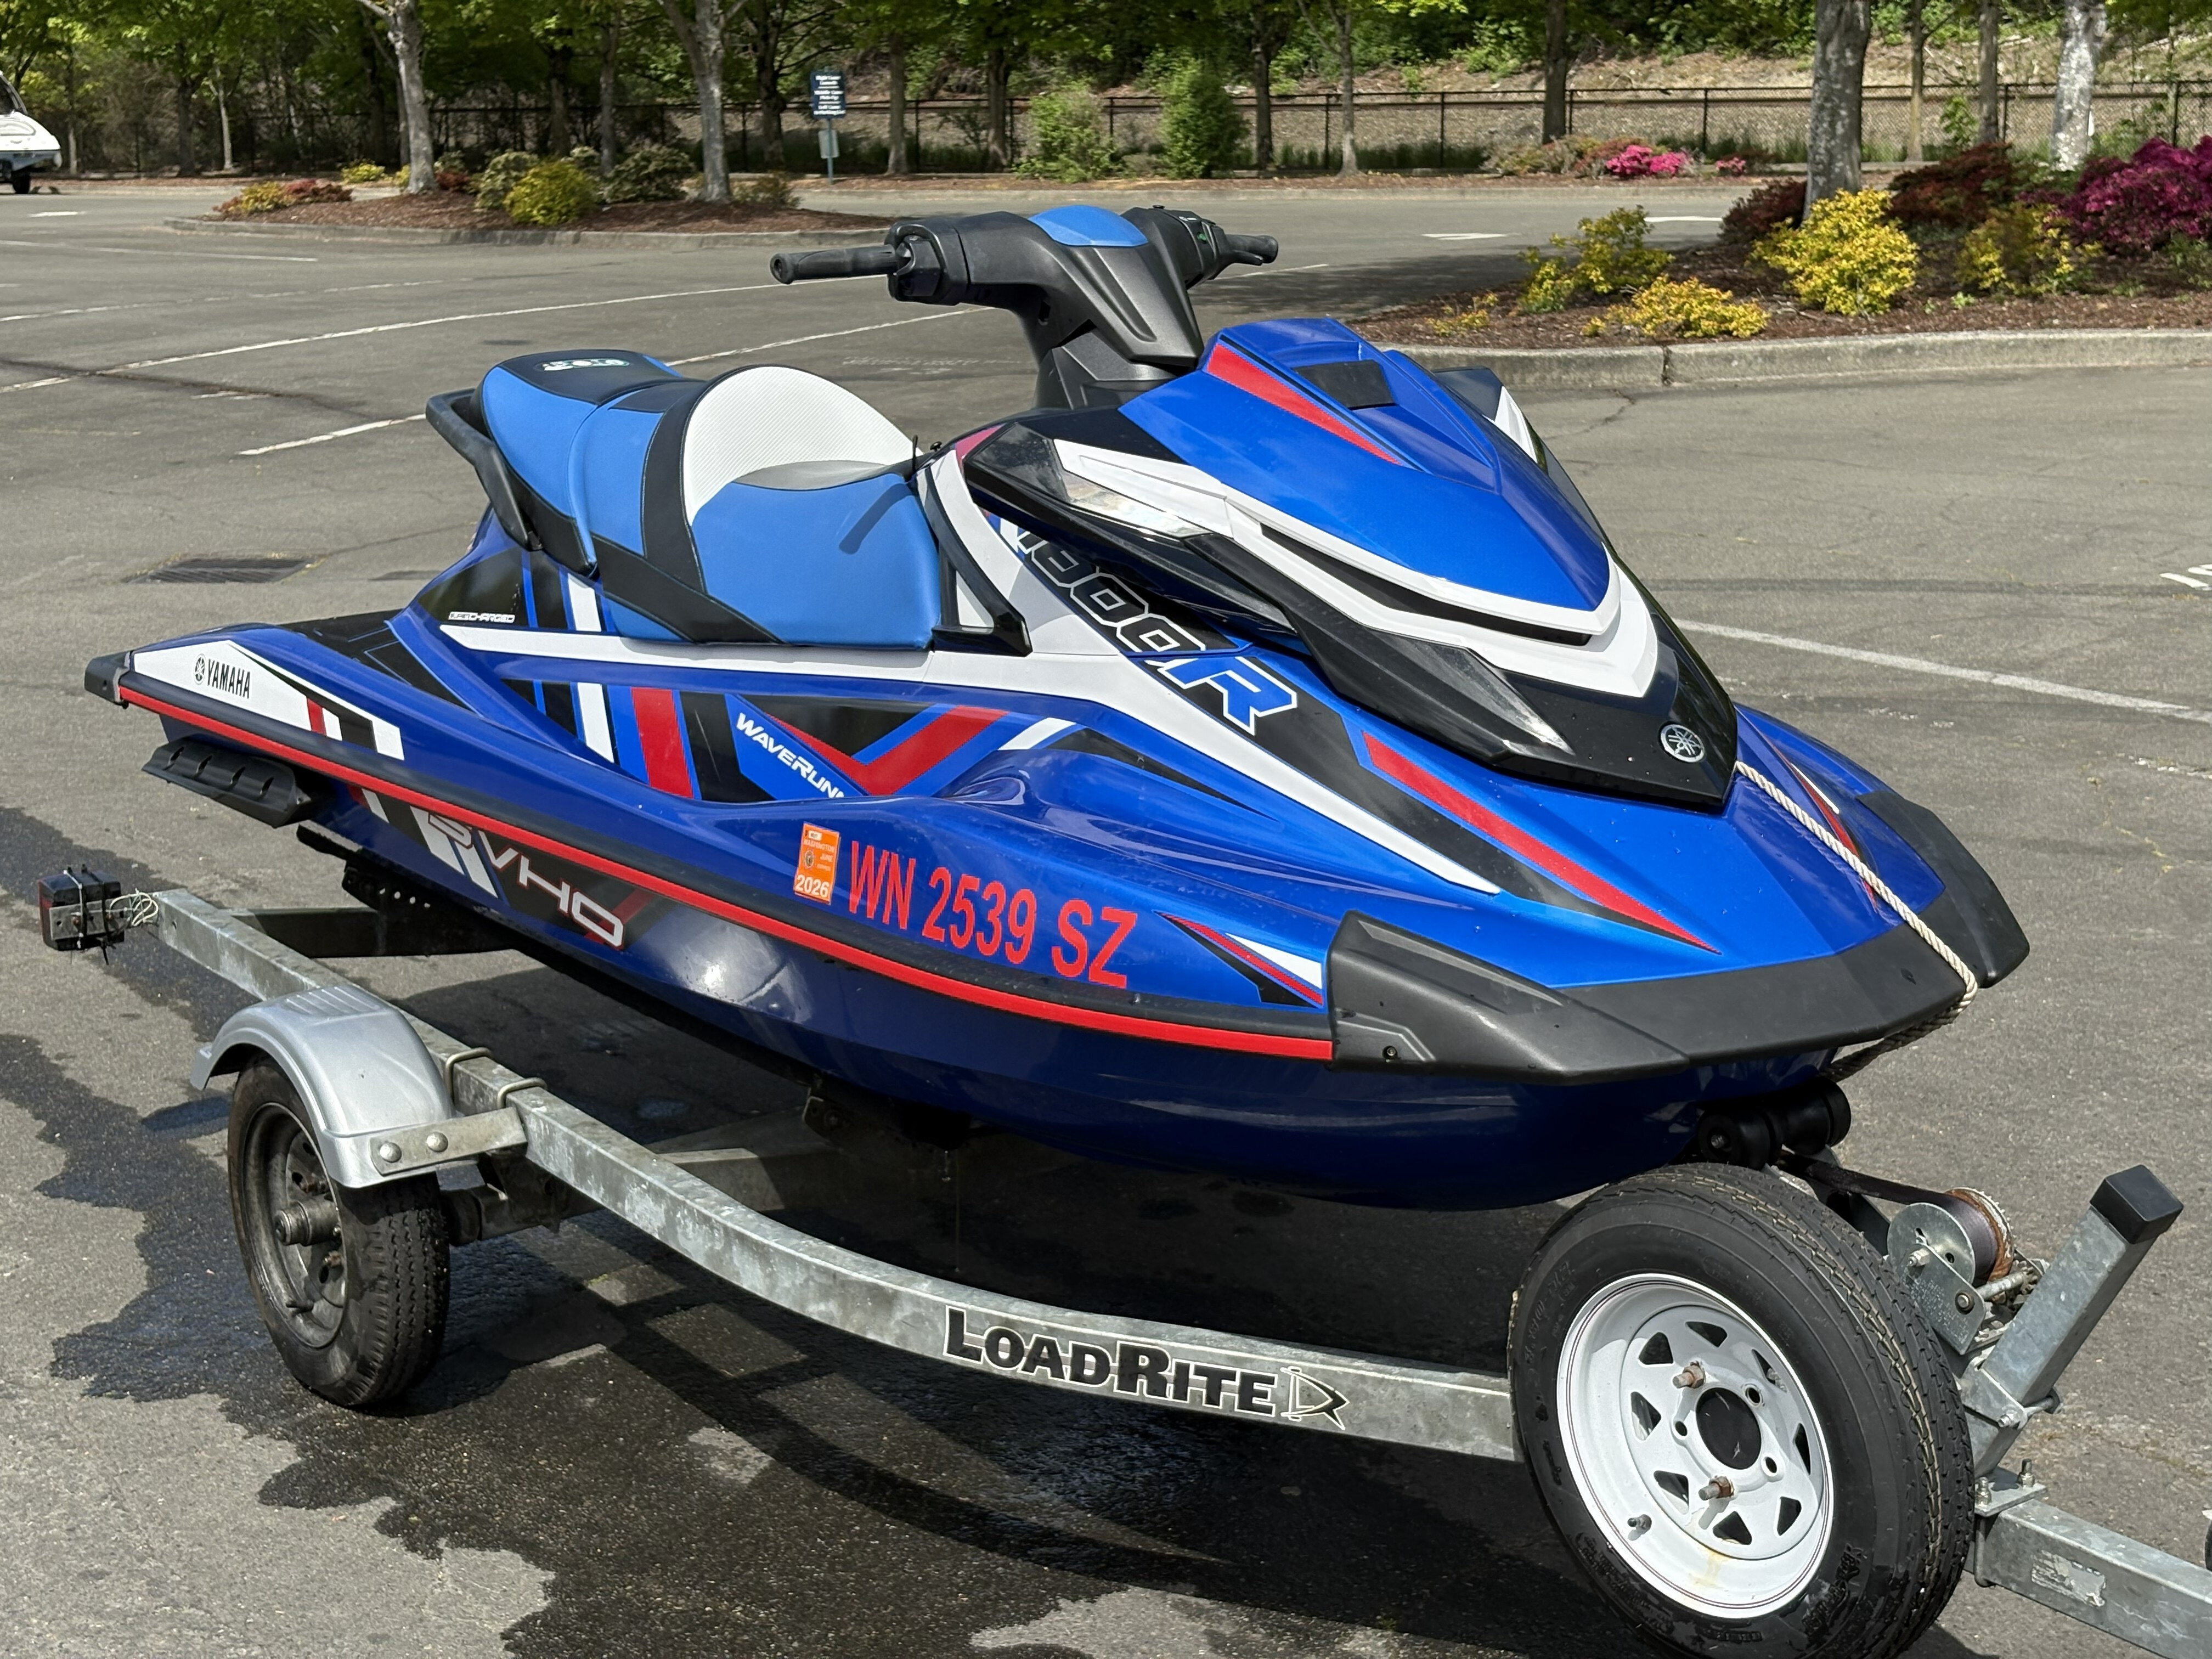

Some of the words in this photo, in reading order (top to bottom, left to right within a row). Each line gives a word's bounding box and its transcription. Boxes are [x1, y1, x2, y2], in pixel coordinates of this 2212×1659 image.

[207, 658, 251, 699] YAMAHA
[736, 712, 844, 798] WAVERUN
[795, 874, 830, 899] 2026
[848, 840, 916, 930] WN
[922, 867, 1037, 964] 2539
[1051, 899, 1138, 989] SZ
